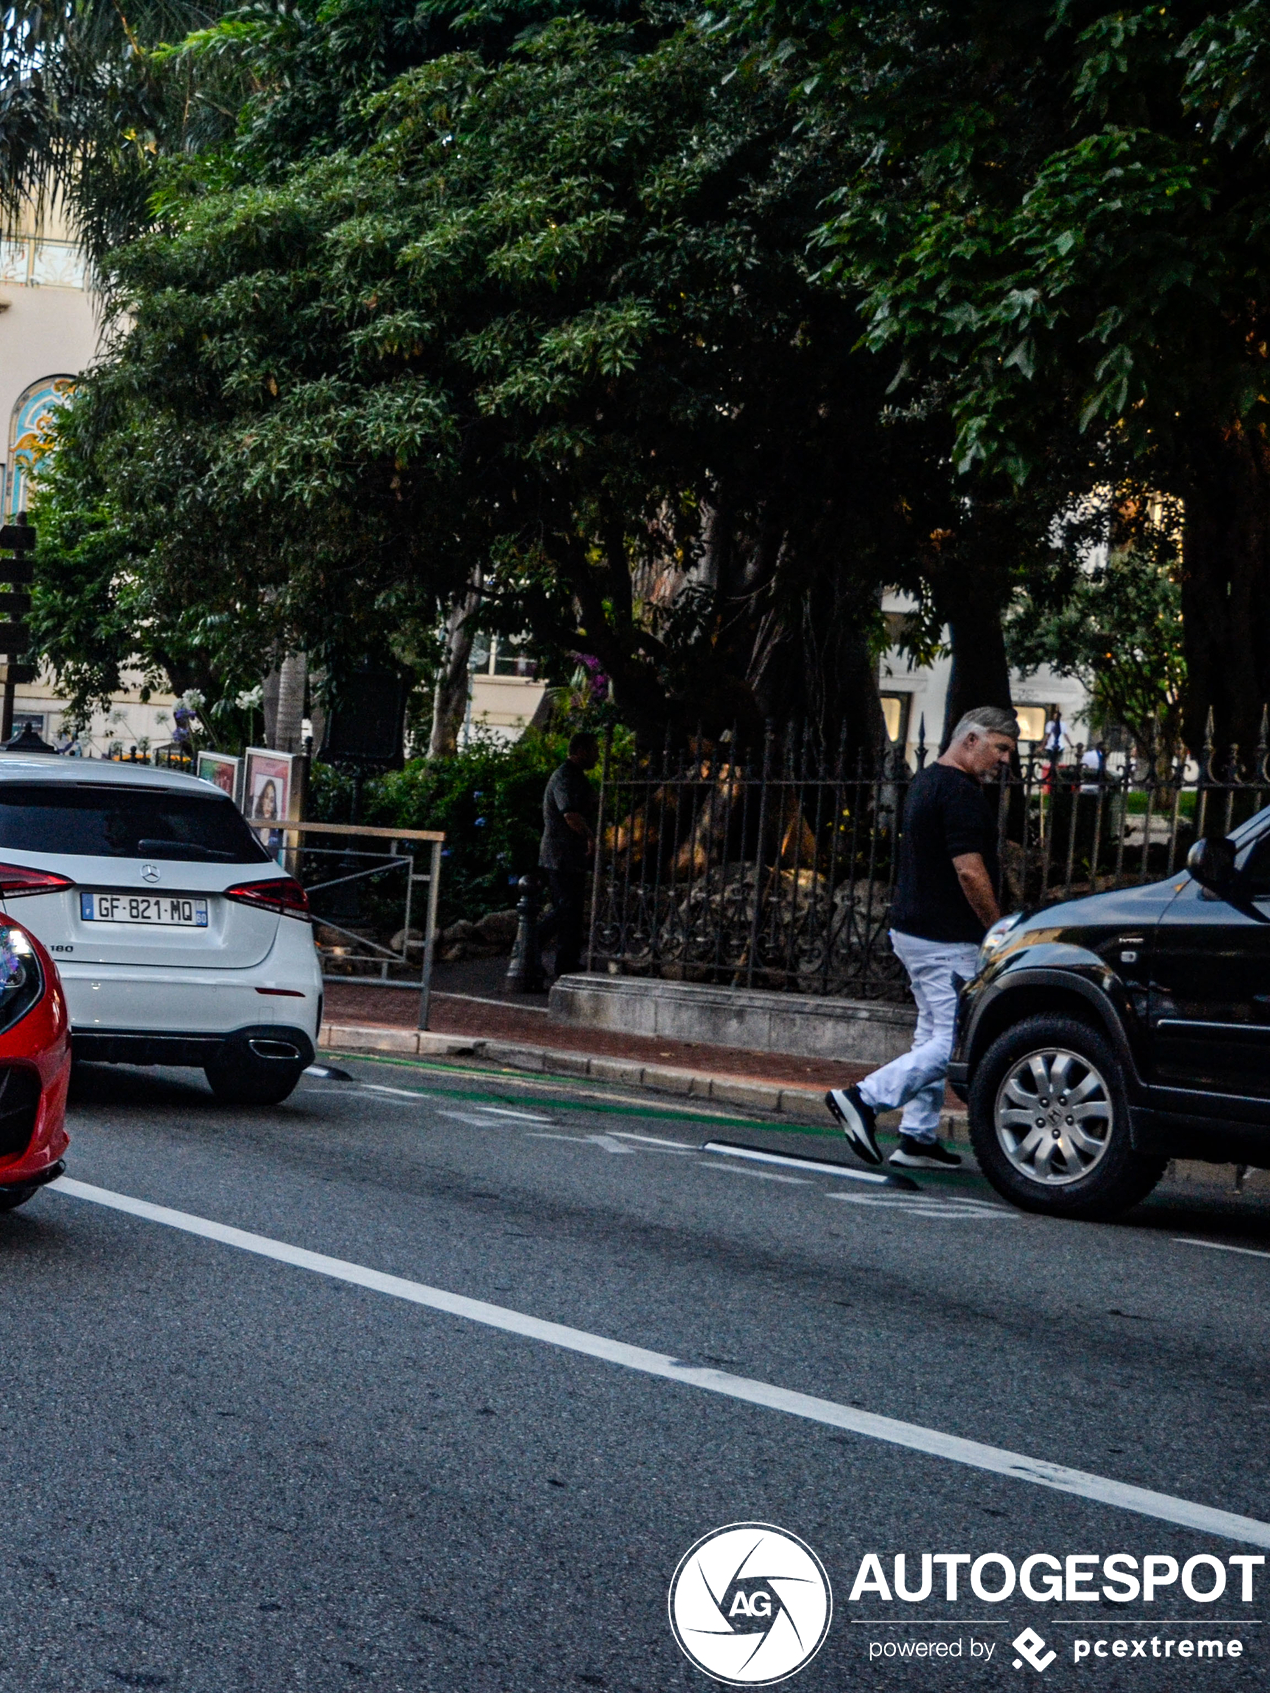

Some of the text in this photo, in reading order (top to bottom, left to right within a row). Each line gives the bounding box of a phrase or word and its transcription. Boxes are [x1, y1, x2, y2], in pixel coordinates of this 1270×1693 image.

[98, 897, 193, 922] GF-821-MQ
[196, 913, 207, 924] 60
[50, 944, 74, 953] 180
